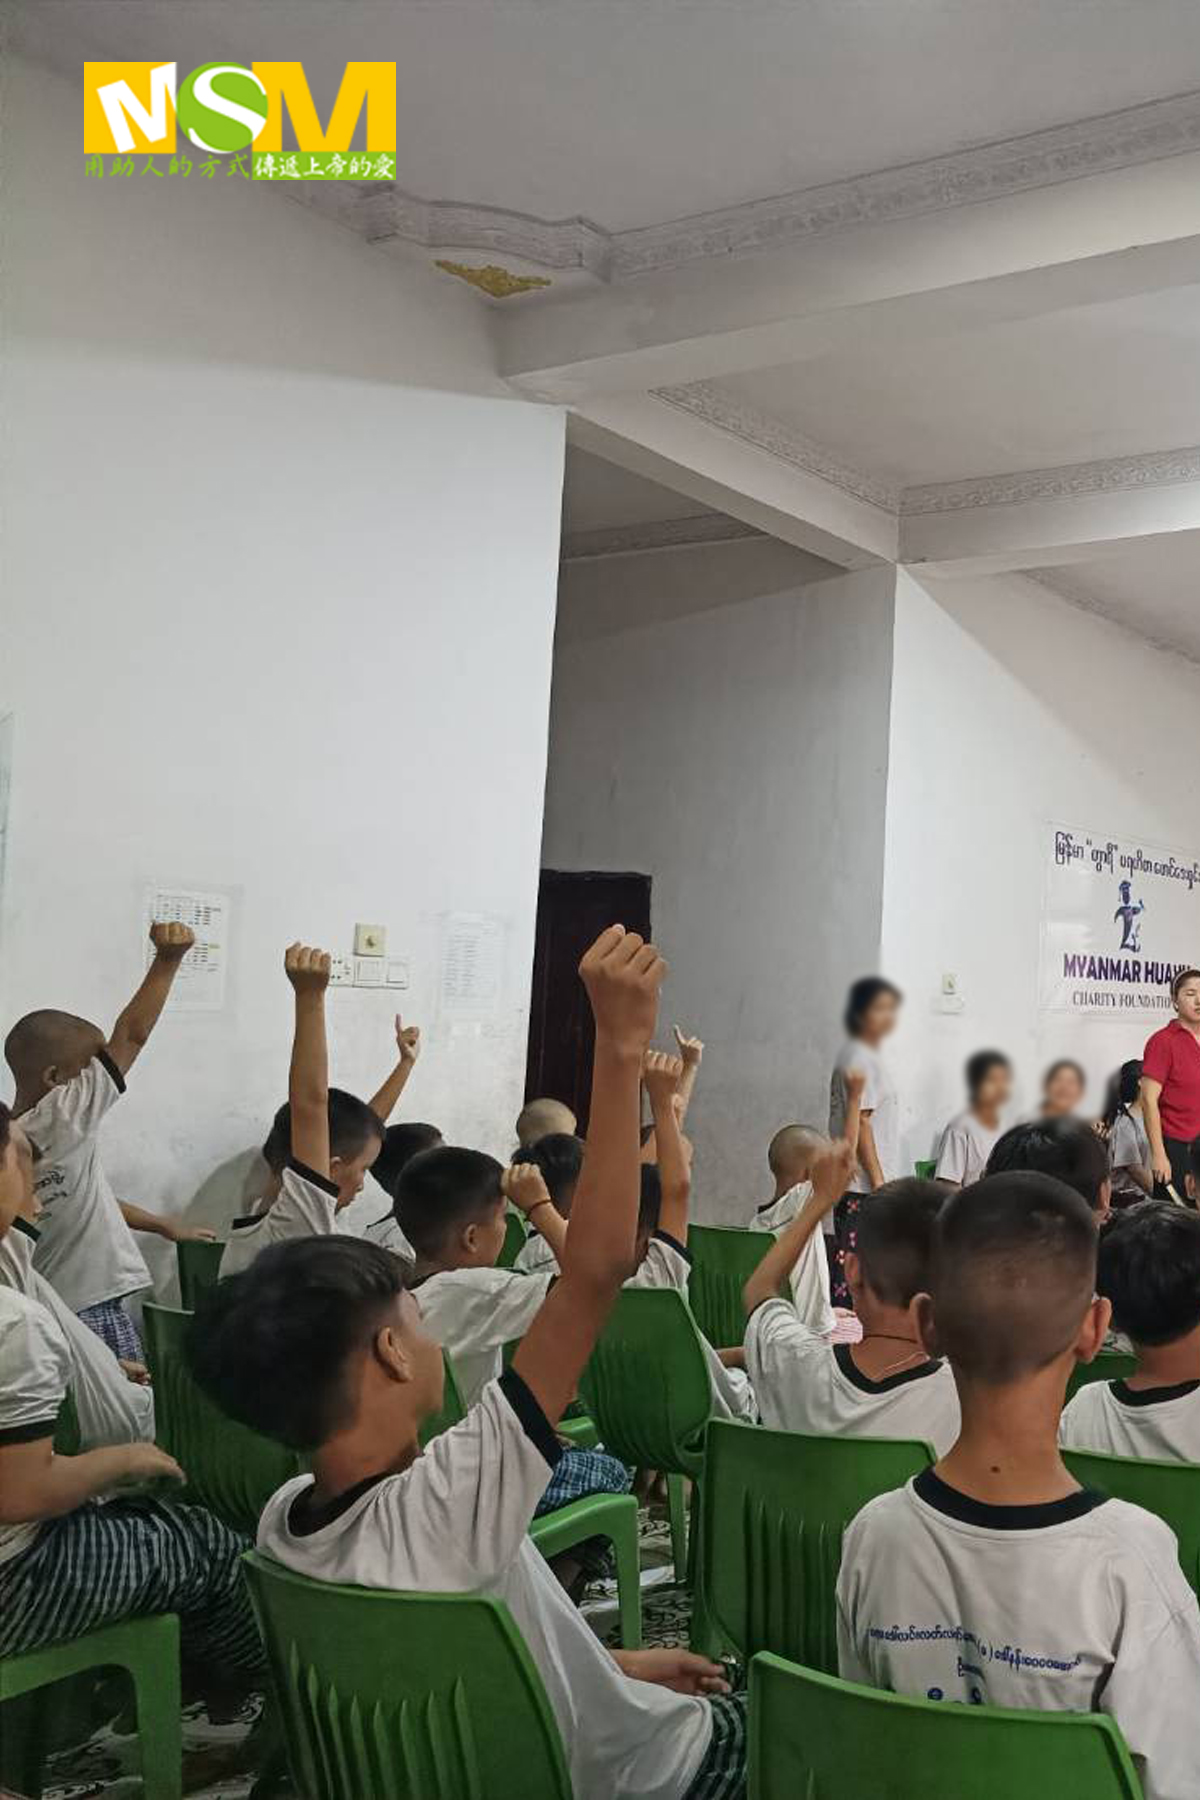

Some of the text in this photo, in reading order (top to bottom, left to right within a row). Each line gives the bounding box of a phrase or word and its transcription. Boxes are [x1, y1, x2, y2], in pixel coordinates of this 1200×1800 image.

[1063, 953, 1141, 983] MYANMAR
[1073, 990, 1172, 1009] CHARITY FOUNDATIO
